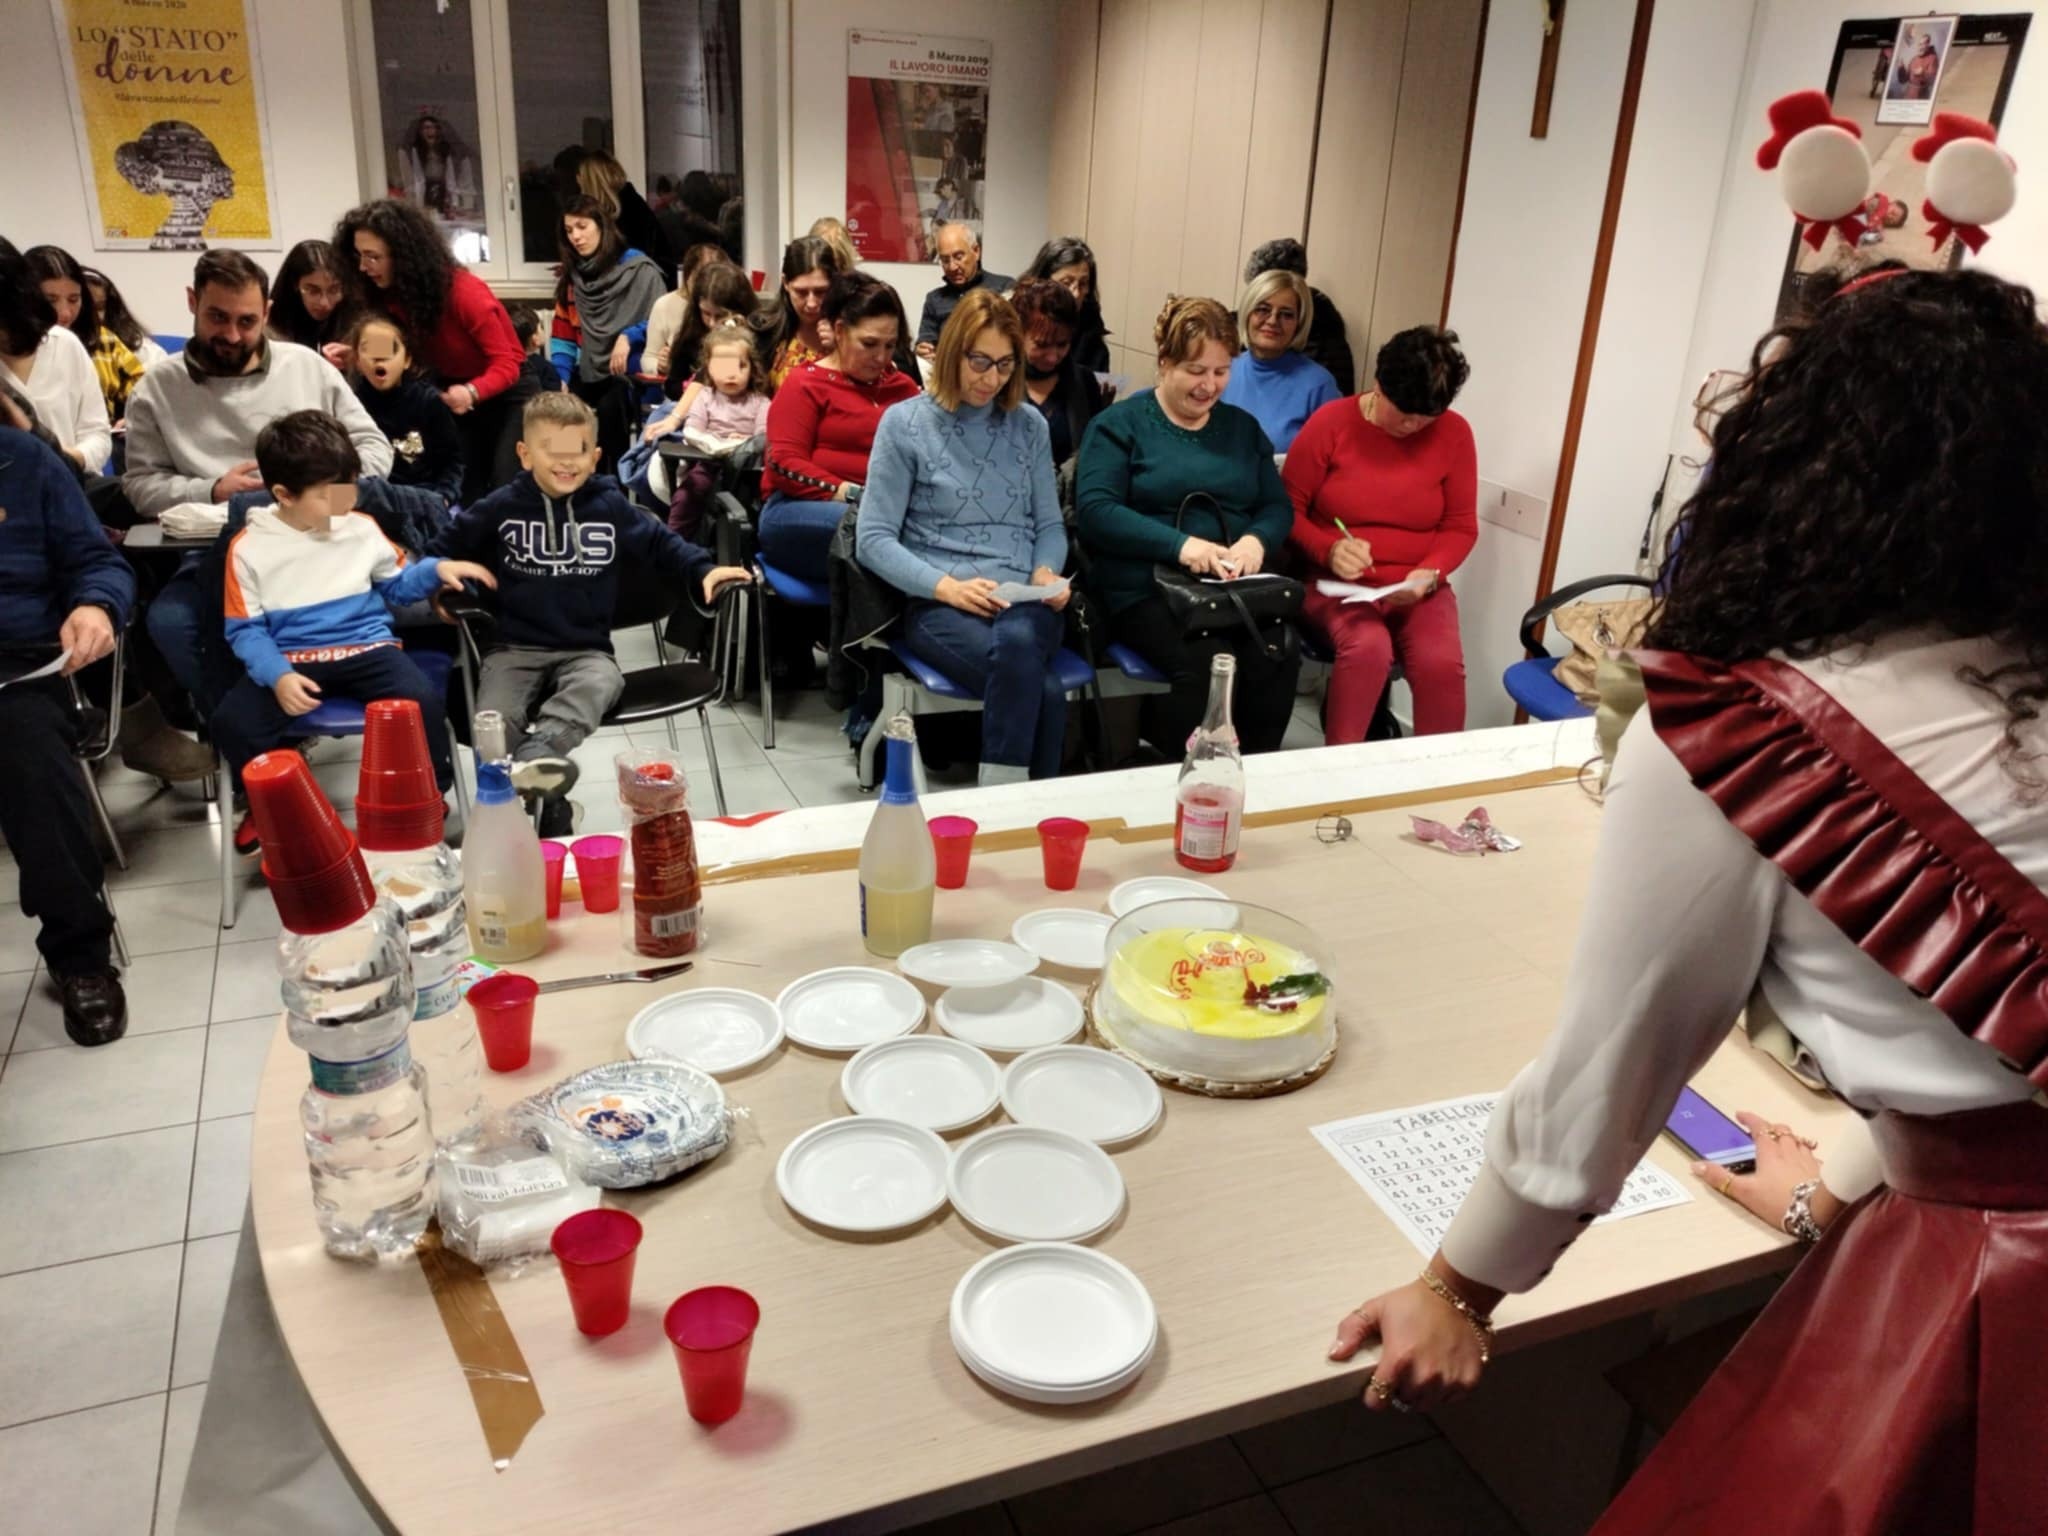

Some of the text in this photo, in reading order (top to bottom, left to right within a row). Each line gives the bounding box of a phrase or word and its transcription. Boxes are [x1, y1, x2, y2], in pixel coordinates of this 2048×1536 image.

[77, 27, 107, 43] LO
[95, 36, 247, 86] donne
[121, 50, 155, 63] delle
[928, 50, 989, 65] 8 Marzo 2019
[890, 59, 898, 69] IL
[901, 61, 945, 73] LAVORO
[947, 65, 989, 77] UMANO
[498, 519, 616, 565] 4US
[1376, 1139, 1384, 1148] 2
[1445, 1124, 1456, 1132] 5
[1360, 1154, 1376, 1164] 11
[1383, 1150, 1399, 1159] 12
[1406, 1146, 1423, 1155] 13
[1429, 1141, 1447, 1151] 14
[1452, 1134, 1470, 1146] 15
[1369, 1146, 1482, 1176] 21 22 23 24 25
[1381, 1164, 1469, 1187] 31 32 33 34
[1392, 1190, 1409, 1199] 41
[1416, 1185, 1433, 1194] 42
[1440, 1179, 1457, 1188] 43
[1402, 1202, 1420, 1211] 51
[1427, 1197, 1445, 1207] 52
[1415, 1214, 1432, 1223] 61
[1426, 1227, 1444, 1236] 71
